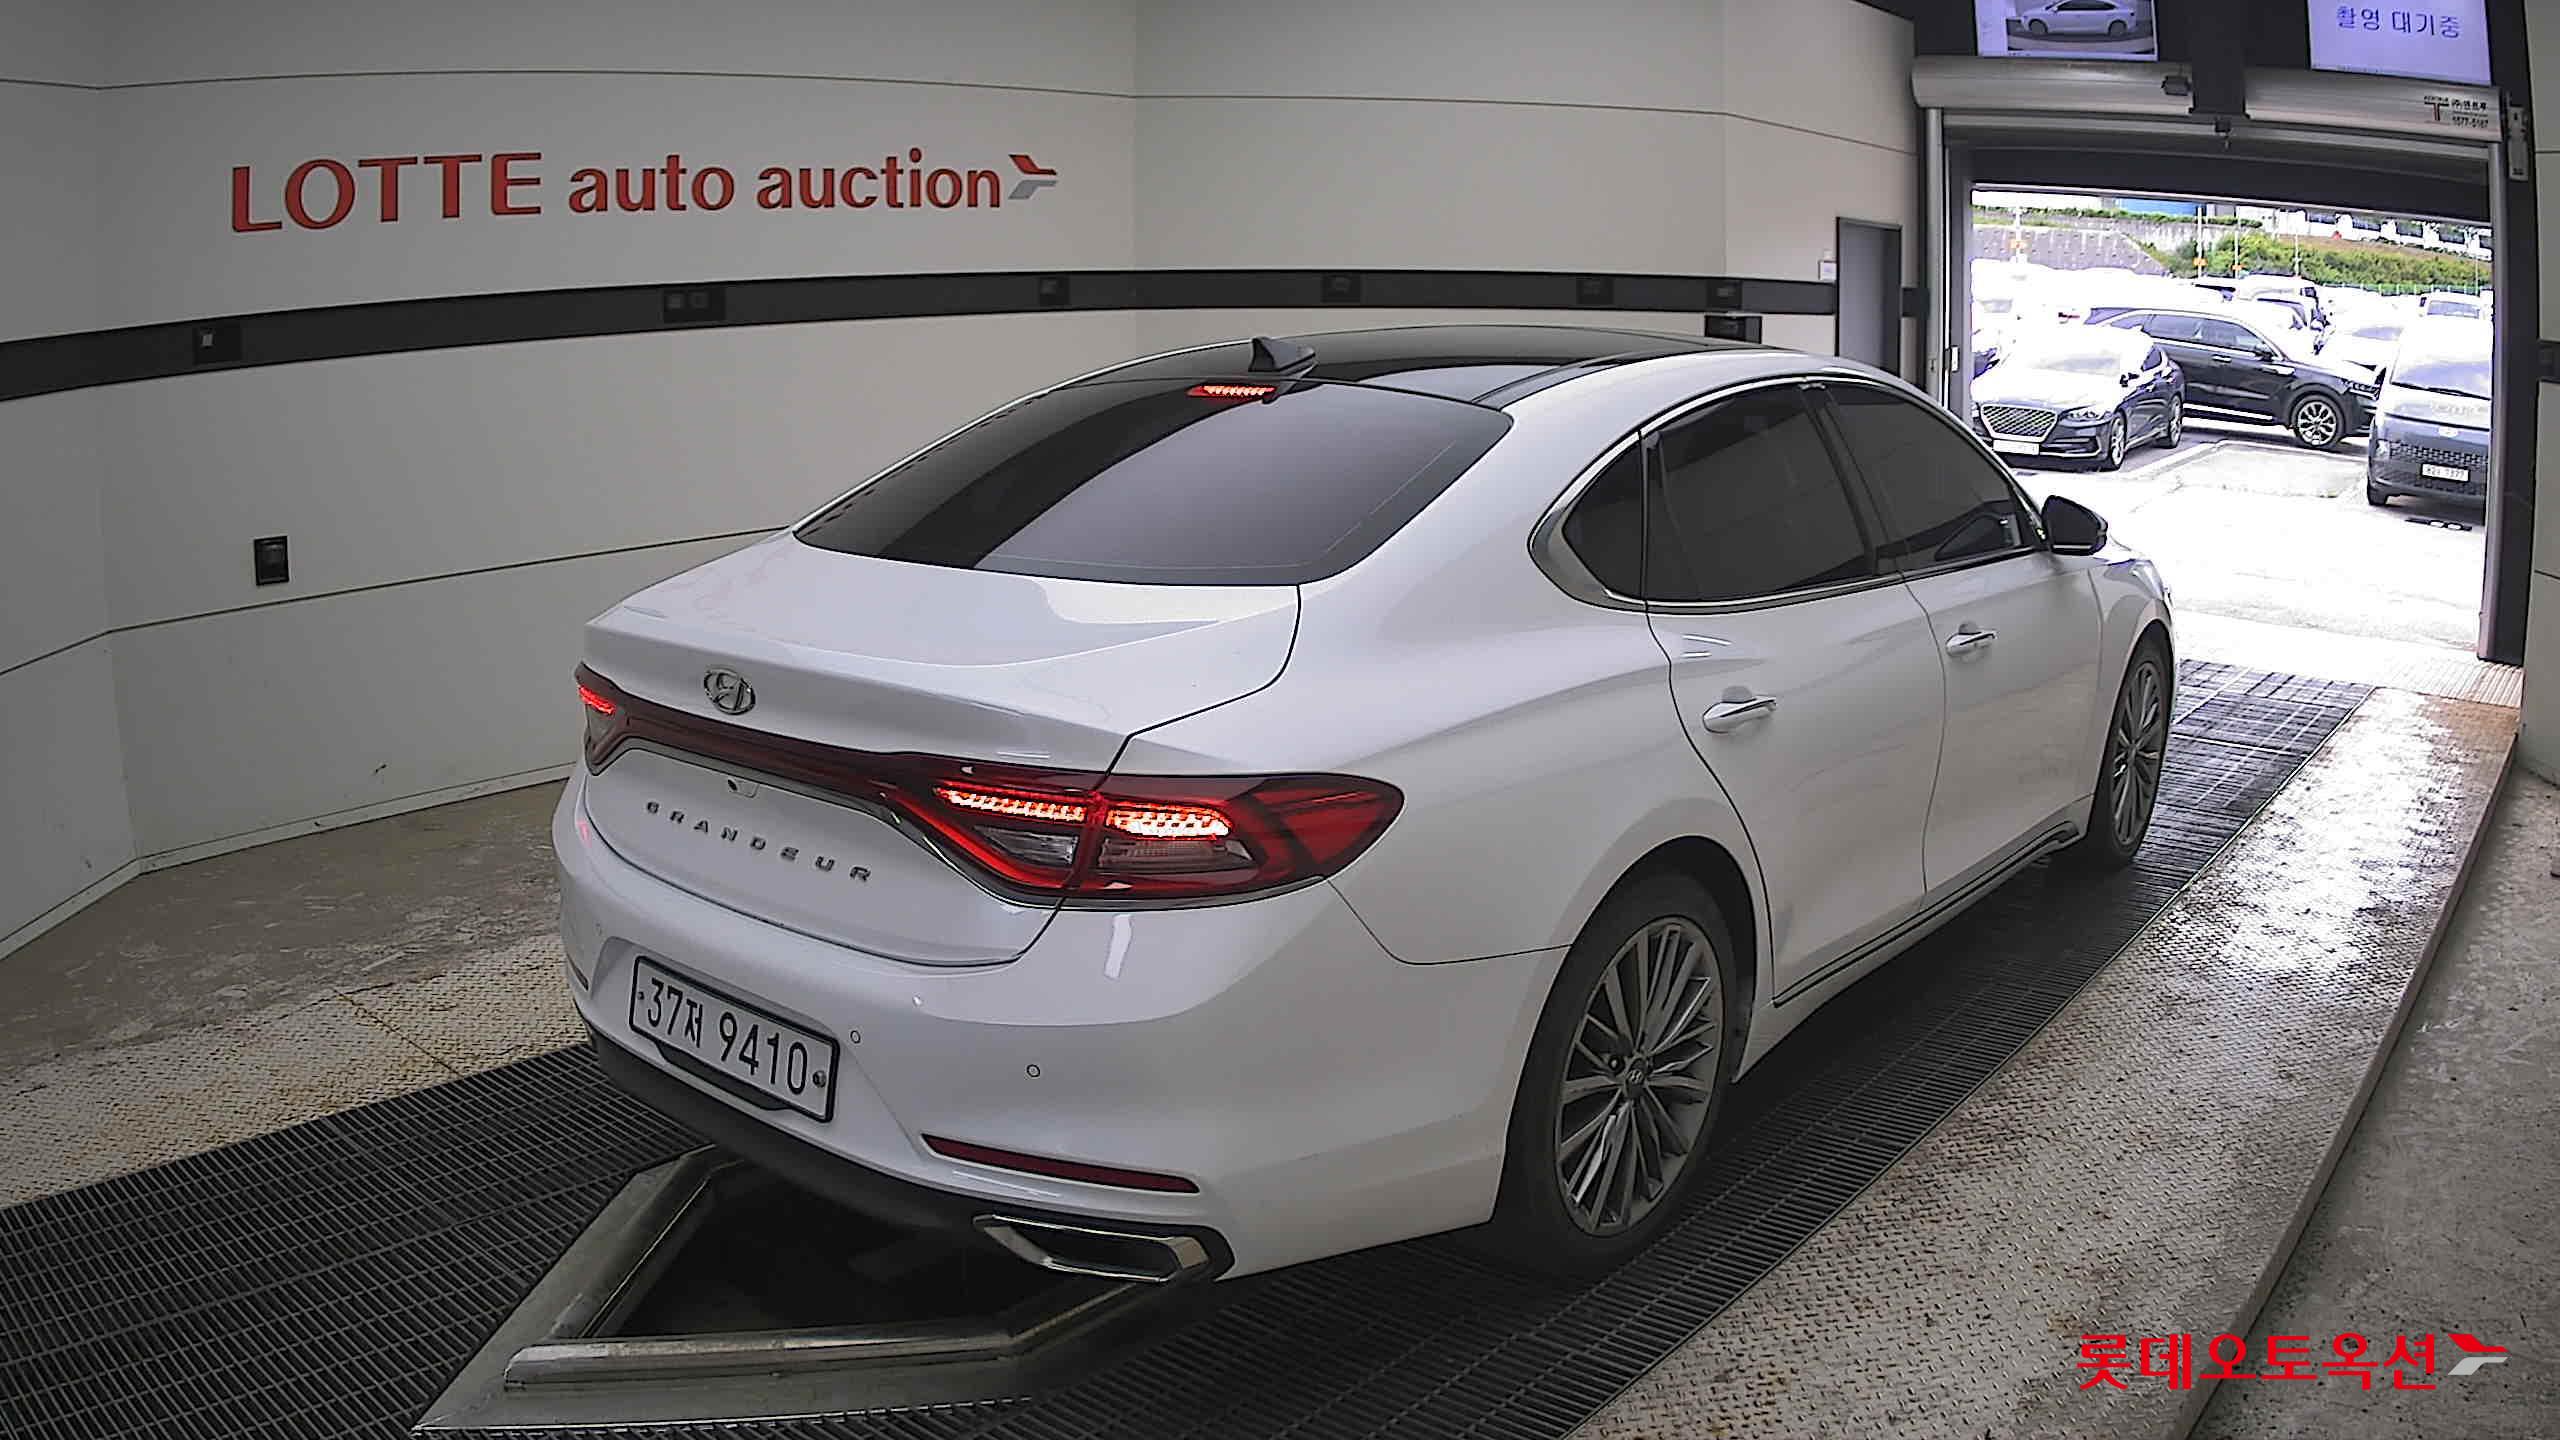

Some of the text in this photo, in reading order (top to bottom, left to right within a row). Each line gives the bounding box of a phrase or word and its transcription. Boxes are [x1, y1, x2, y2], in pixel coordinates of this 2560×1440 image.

[2337, 5, 2460, 39] 촬영 대기중
[232, 147, 1002, 232] LOTTE auto auction
[646, 801, 871, 882] GRANDEUR
[647, 976, 808, 1095] 37저 9410
